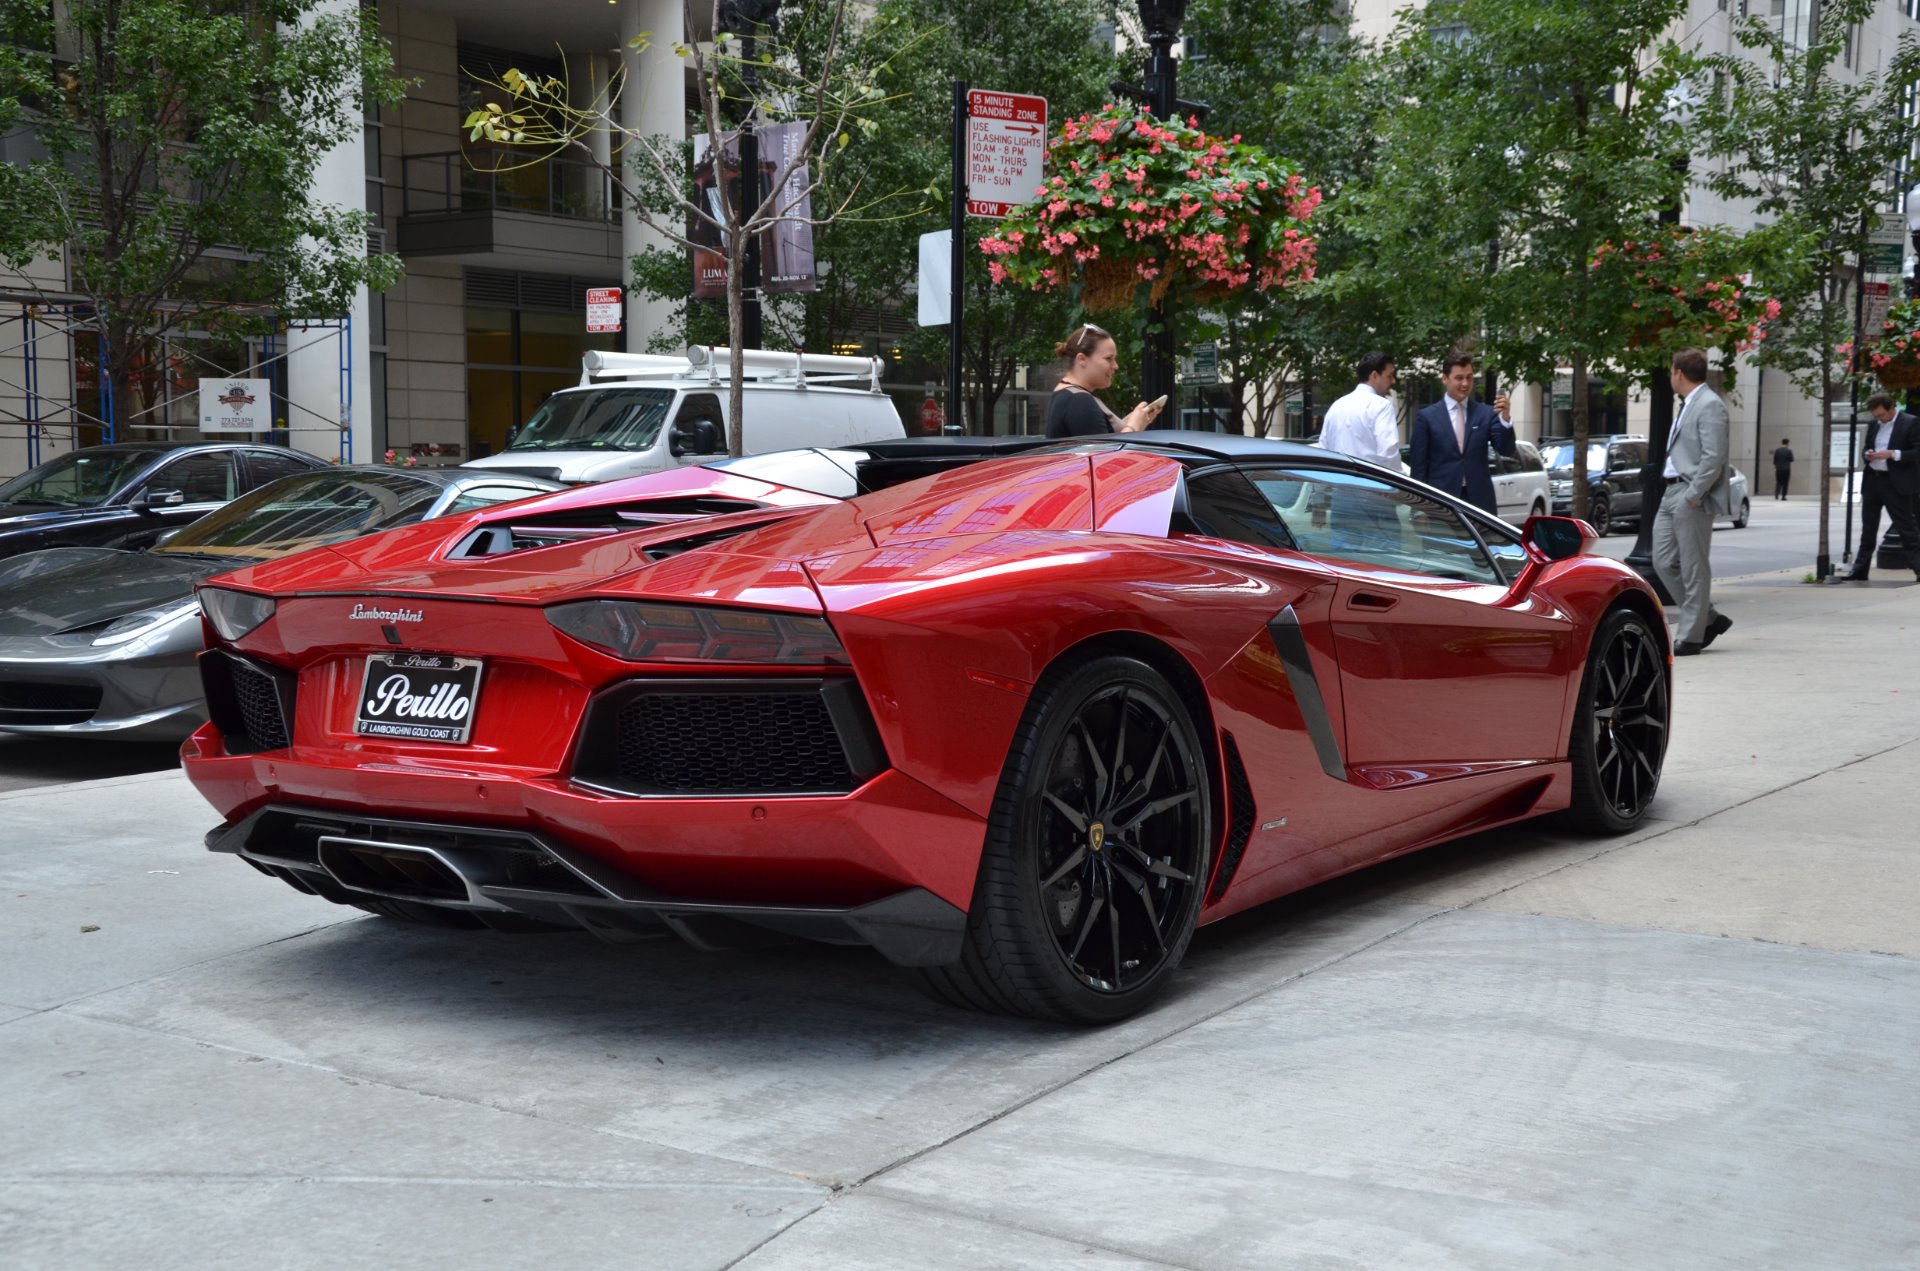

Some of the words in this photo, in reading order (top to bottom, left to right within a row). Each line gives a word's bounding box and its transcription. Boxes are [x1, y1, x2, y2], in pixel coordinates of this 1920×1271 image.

[973, 94, 982, 104] 15
[984, 96, 1014, 108] MINUTE
[973, 105, 1012, 118] STANDING
[1016, 110, 1038, 120] ZONE
[973, 122, 989, 132] USE
[973, 132, 1012, 144] FLASHING
[1014, 136, 1041, 148] LIGHTS
[1004, 146, 1009, 154] 8
[1012, 146, 1024, 156] PM
[973, 154, 991, 163] MON
[1000, 156, 1028, 167] THURS
[1004, 167, 1009, 176] 6
[1011, 167, 1023, 177] PM
[972, 174, 986, 184] FRI
[994, 176, 1011, 186] SUN
[972, 202, 998, 215] TOW
[224, 381, 250, 391] UNITED
[349, 604, 423, 623] Lamborghini
[404, 655, 441, 667] Perillo
[367, 674, 470, 720] Perillo
[369, 724, 411, 735] LAMBORGHINI
[412, 728, 429, 738] GOLD
[430, 730, 450, 739] COAST
